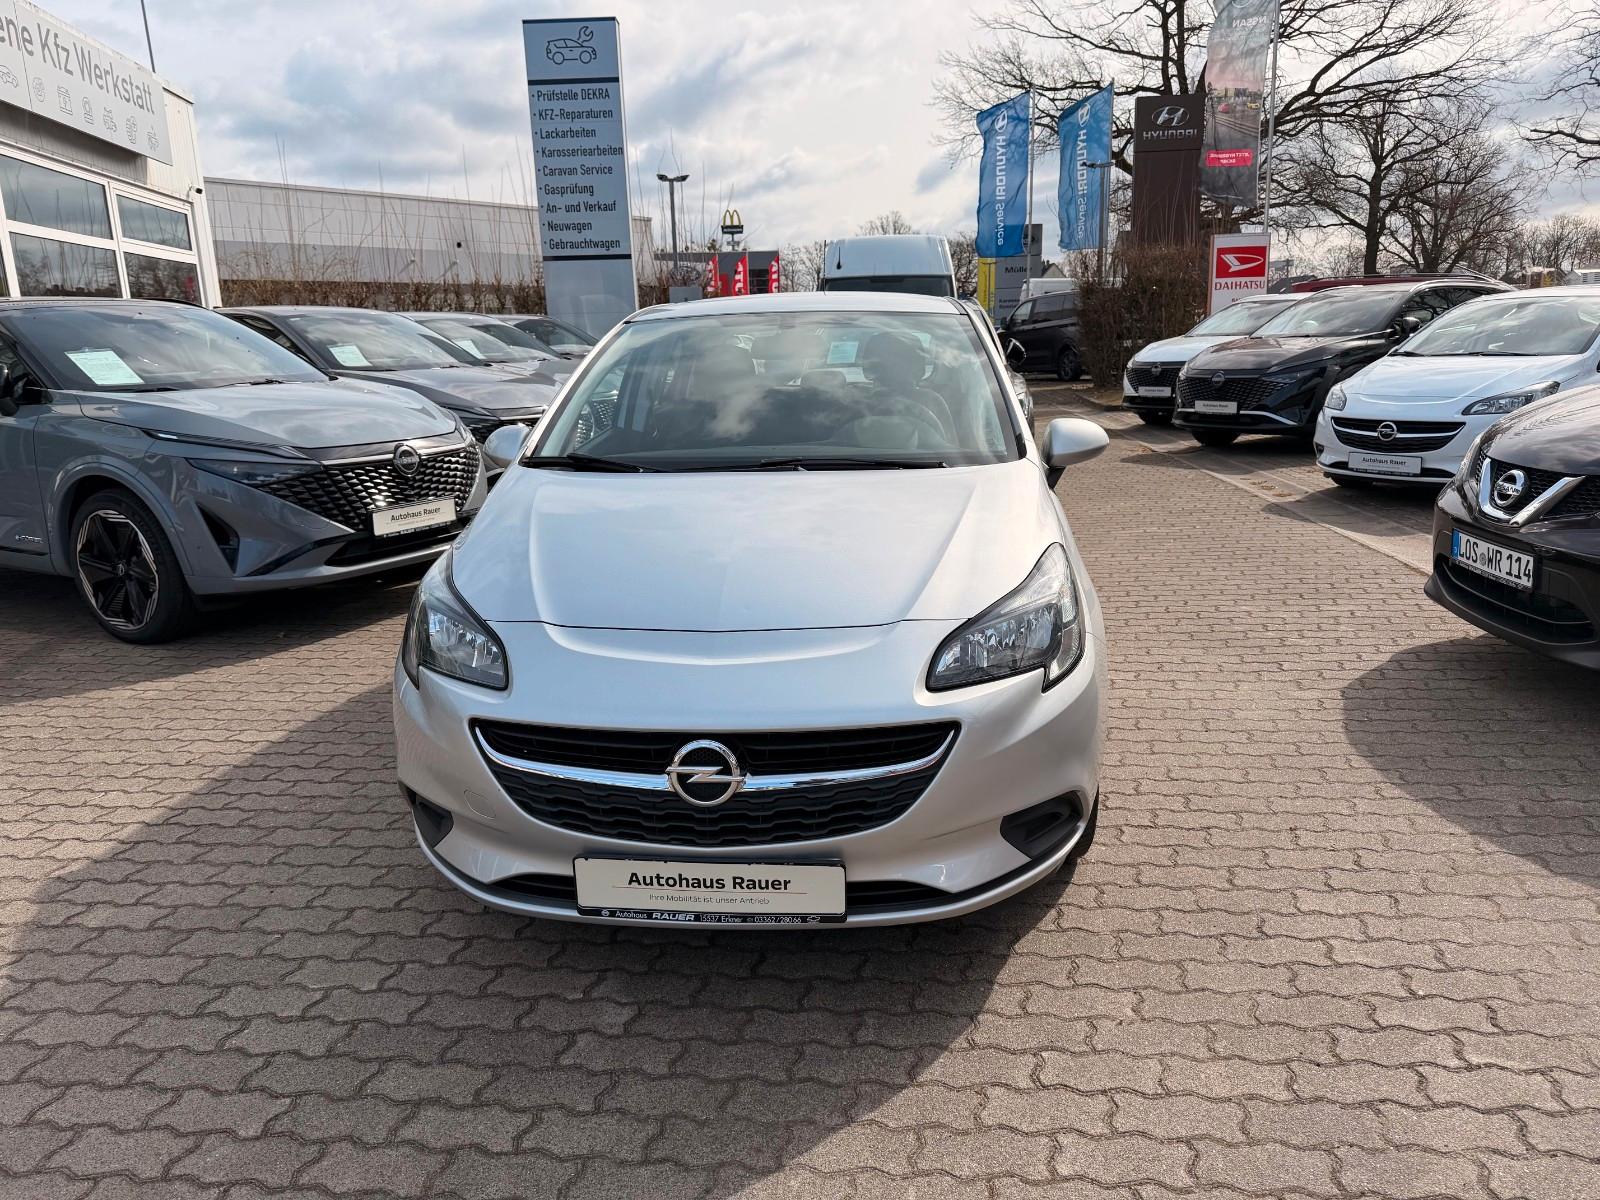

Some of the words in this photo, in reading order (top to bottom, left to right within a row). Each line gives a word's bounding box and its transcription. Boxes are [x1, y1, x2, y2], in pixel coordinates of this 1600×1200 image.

[37, 23, 74, 76] Kfz
[73, 42, 155, 115] Werkstatt
[537, 90, 579, 102] Prüfstelle
[581, 88, 610, 100] DEKRA
[538, 108, 613, 122] KFZ-Reparaturen
[540, 126, 597, 139] Lackarbeiten
[1143, 129, 1198, 140] HYUNDAI
[541, 144, 624, 158] Karosseriearbeiten
[543, 165, 578, 176] Caravan
[580, 163, 613, 175] Service
[544, 183, 594, 197] Gasprüfung
[546, 202, 562, 213] An-
[565, 201, 581, 213] und
[583, 200, 617, 212] Verkauf
[547, 220, 593, 234] Neuwagen
[549, 237, 621, 251] Gebrauchtwagen
[1214, 280, 1265, 291] DAIHATSU
[391, 510, 422, 522] Autohaus
[423, 507, 441, 516] Rauer
[1458, 535, 1478, 563] LOS
[1487, 546, 1502, 573] WR
[1505, 553, 1532, 583] 114
[627, 872, 726, 889] Autohaus
[732, 876, 791, 890] Rauer
[666, 894, 702, 903] Mobilität
[739, 897, 770, 905] Antrieb
[615, 910, 648, 919] Autohaus
[652, 912, 695, 921] RAUER
[700, 914, 719, 922] 15537
[721, 915, 743, 923] Erkner
